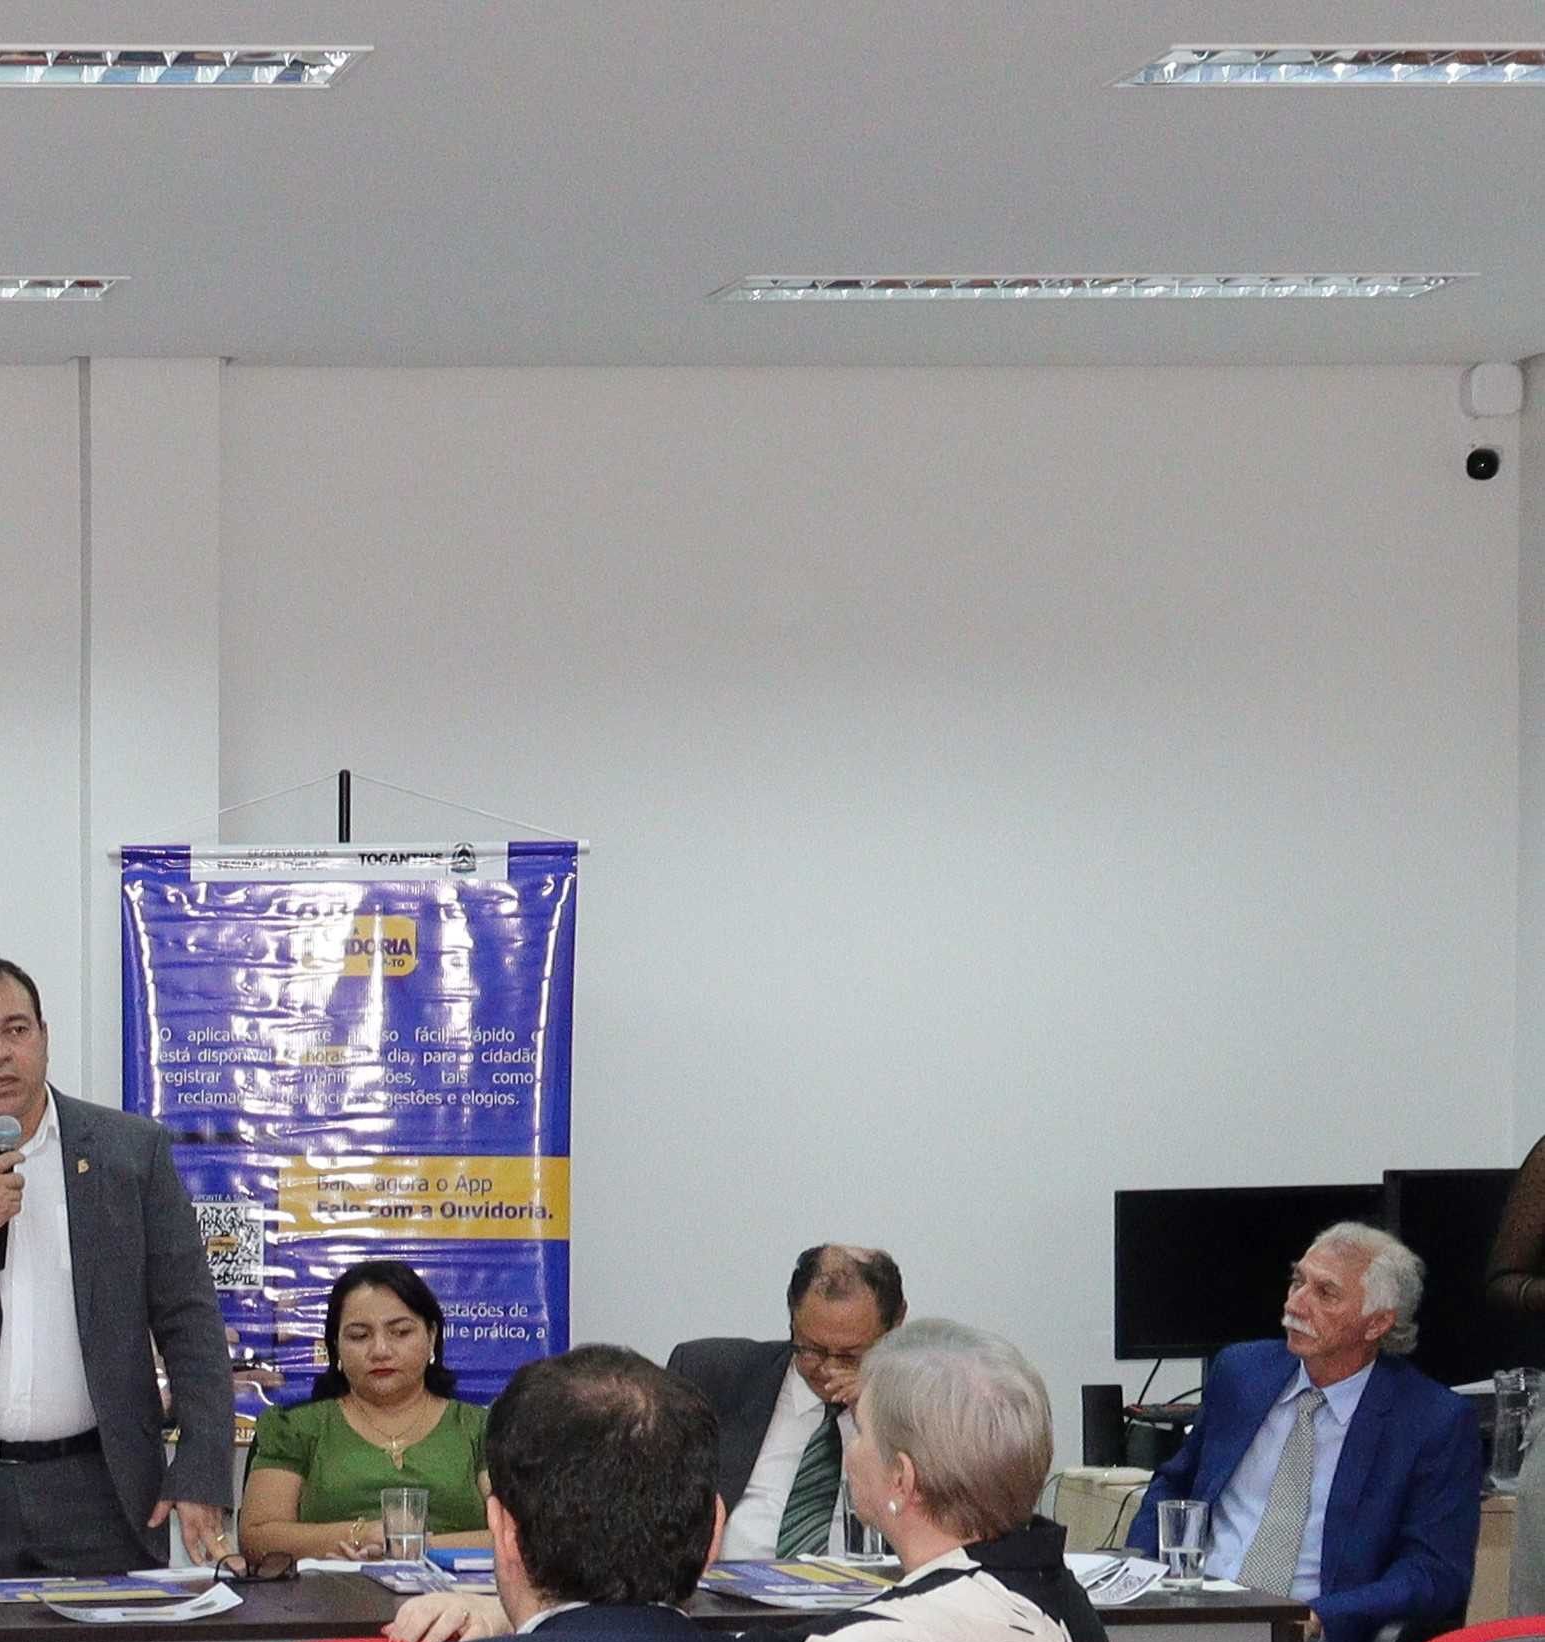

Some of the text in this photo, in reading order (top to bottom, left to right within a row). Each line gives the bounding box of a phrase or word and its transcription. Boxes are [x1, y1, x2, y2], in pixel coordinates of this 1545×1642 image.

[160, 1047, 191, 1063] está
[447, 1092, 457, 1105] e
[462, 1090, 520, 1108] elogios.
[436, 1177, 448, 1192] o
[455, 1174, 493, 1195] App
[368, 1202, 414, 1218] com
[440, 1201, 554, 1220] Ouvidoria.
[509, 1302, 528, 1318] de
[459, 1326, 470, 1338] e
[474, 1320, 530, 1341] prática,
[535, 1327, 546, 1339] a
